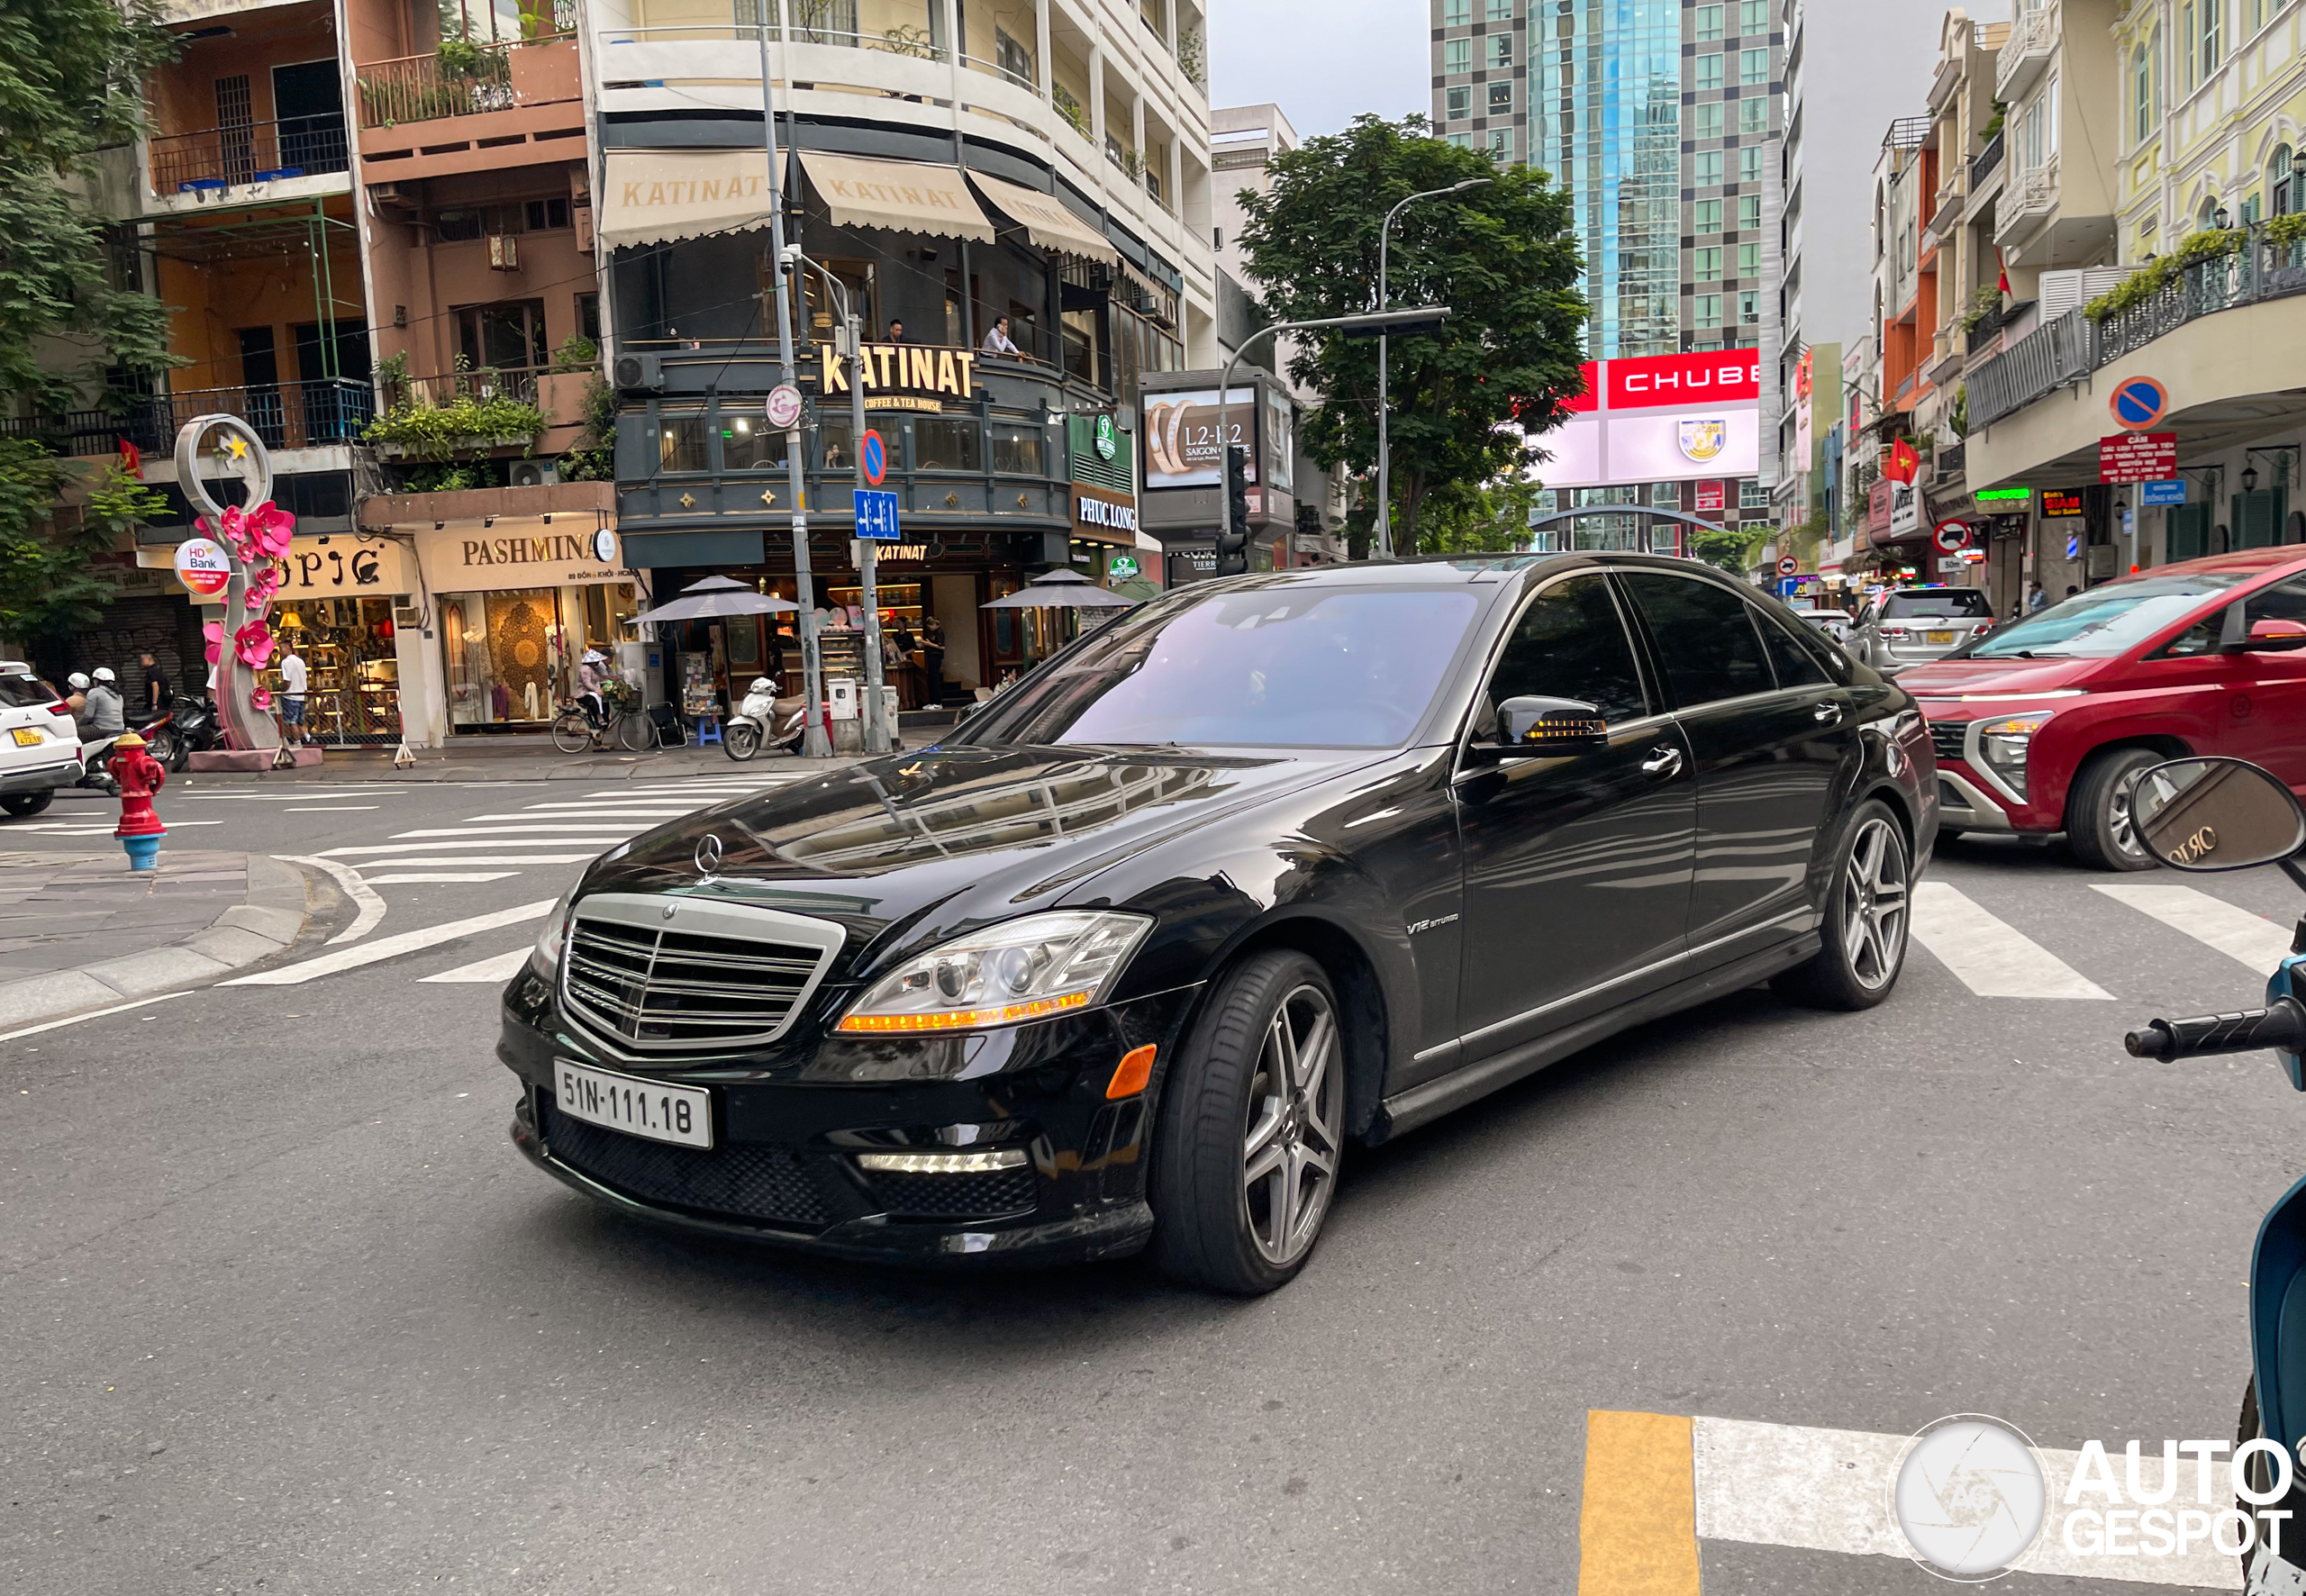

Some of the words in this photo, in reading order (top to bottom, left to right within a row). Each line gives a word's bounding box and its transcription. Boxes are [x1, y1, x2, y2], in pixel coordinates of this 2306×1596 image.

[622, 176, 764, 207] KATINAT
[828, 179, 962, 210] KATINAT
[822, 344, 974, 398] KATINAT
[865, 398, 892, 409] COFFEE
[893, 398, 900, 407] &
[901, 398, 915, 408] TEA
[918, 399, 940, 412] HOUSE
[1186, 447, 1218, 456] SAIGON
[2045, 497, 2080, 510] SIAM
[1080, 497, 1109, 526] PHUC
[1110, 503, 1135, 531] LONG
[189, 548, 205, 558] HD
[876, 545, 927, 561] KATINAT
[190, 558, 216, 568] Bank
[1407, 919, 1430, 935] V12
[1430, 913, 1459, 928] BITURBO
[564, 1072, 692, 1134] 51N-111.18
